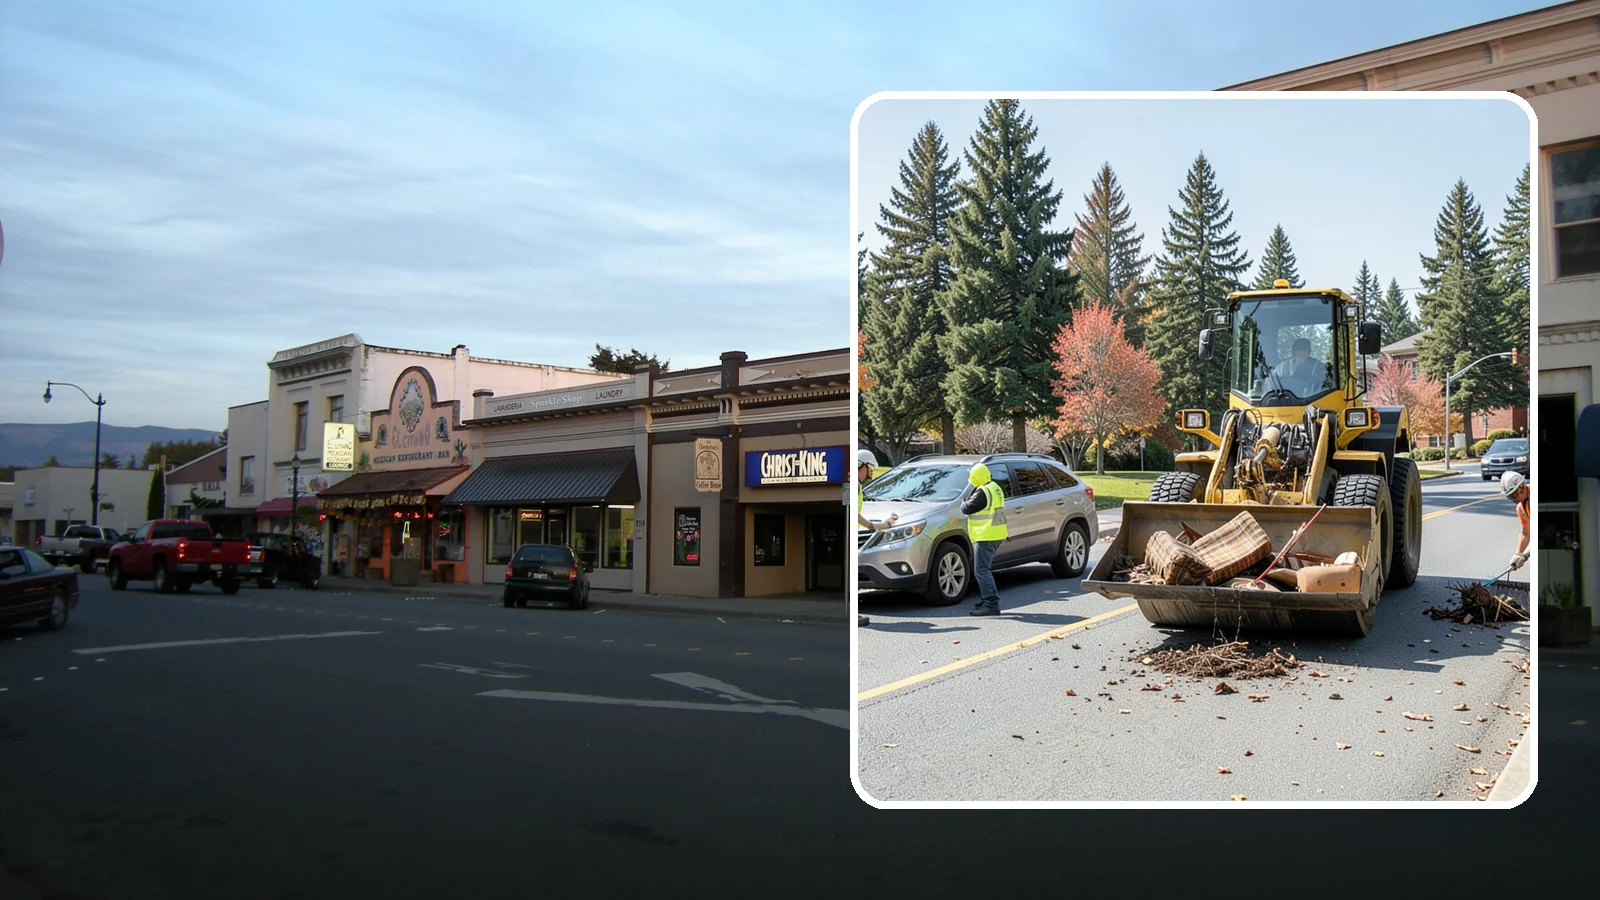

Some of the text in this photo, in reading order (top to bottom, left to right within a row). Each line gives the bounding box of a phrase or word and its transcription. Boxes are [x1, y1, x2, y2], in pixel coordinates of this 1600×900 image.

[595, 389, 624, 400] LAUNDRY
[493, 402, 523, 413] LAVANDERIA
[530, 394, 583, 409] Sparkle Shop
[373, 450, 450, 464] MEXICAN RESTAURANT BAR
[761, 452, 796, 478] CHRIST
[799, 450, 827, 476] KING
[696, 480, 709, 488] Coffee
